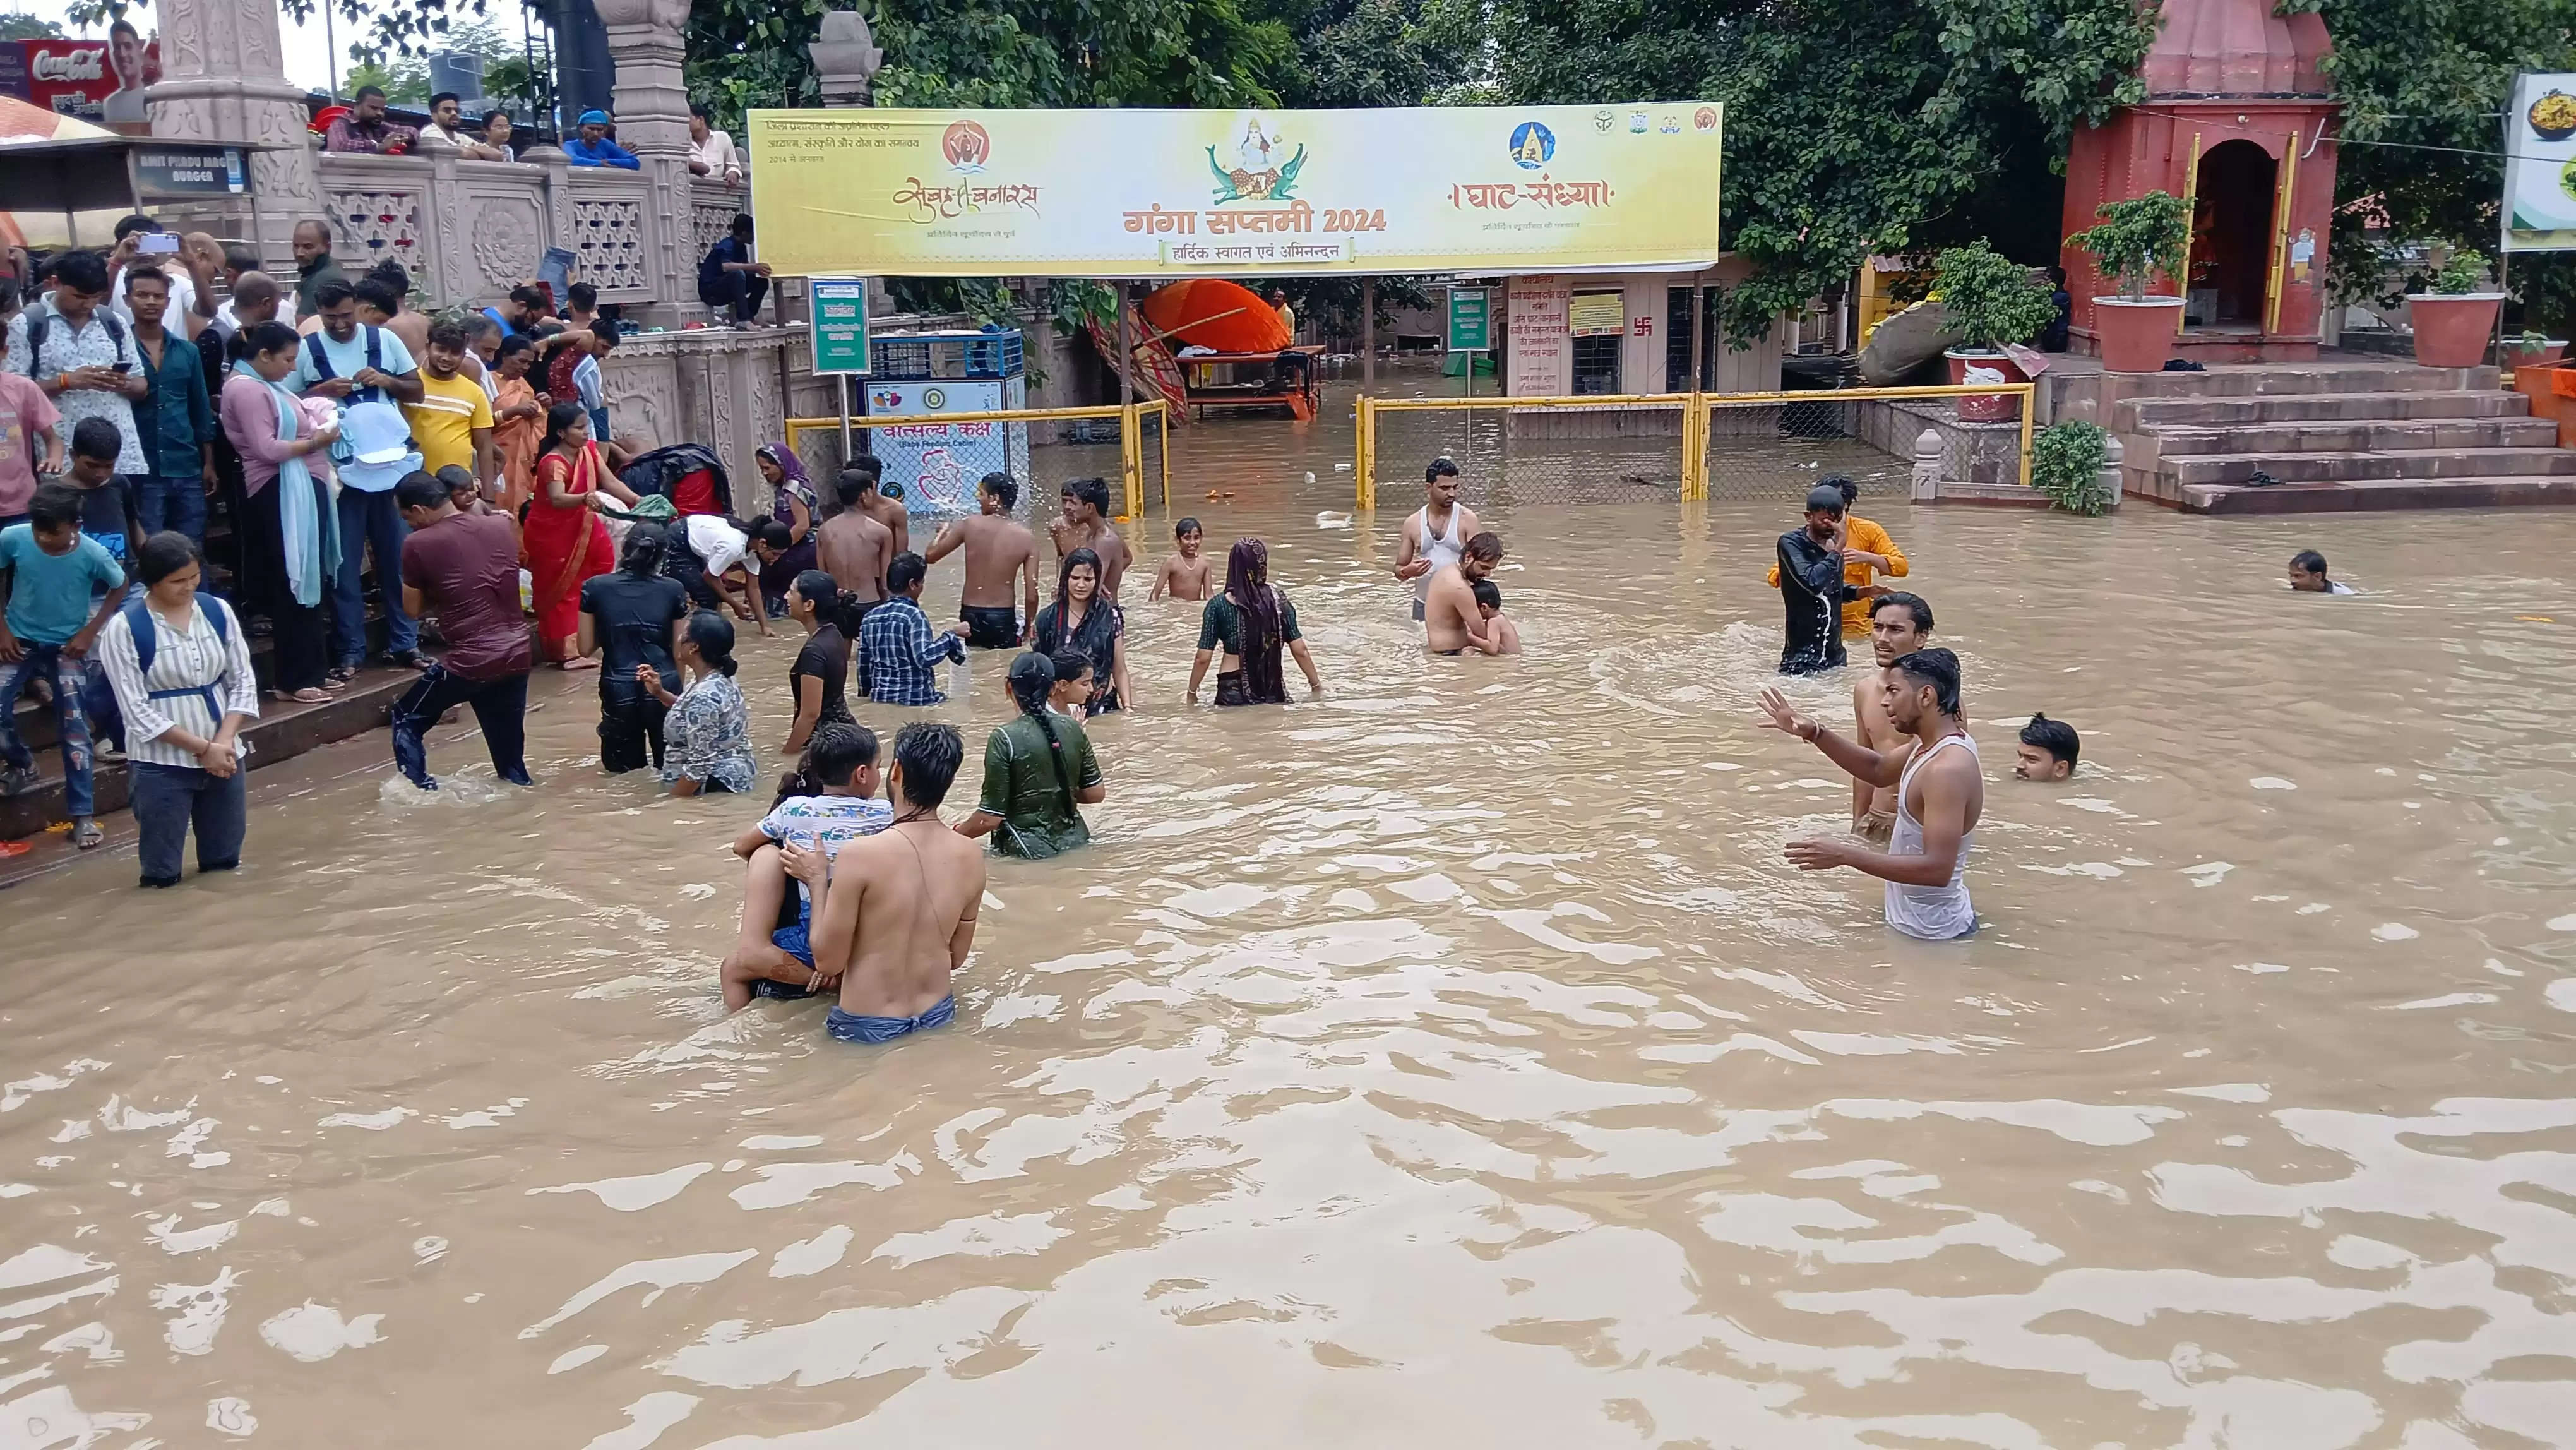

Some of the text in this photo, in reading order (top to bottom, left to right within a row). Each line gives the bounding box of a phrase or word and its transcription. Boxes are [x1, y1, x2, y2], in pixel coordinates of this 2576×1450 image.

[33, 48, 104, 81] Coca-Cola
[804, 137, 835, 150] संस्कृति
[837, 137, 853, 147] और
[172, 171, 213, 182] BURGER
[1123, 200, 1388, 234] गंगा सप्तमी 2024
[1172, 244, 1208, 260] हार्दिक
[1215, 247, 1251, 259] स्वागत
[1257, 243, 1274, 258] एवं
[958, 422, 991, 436] कक्ष
